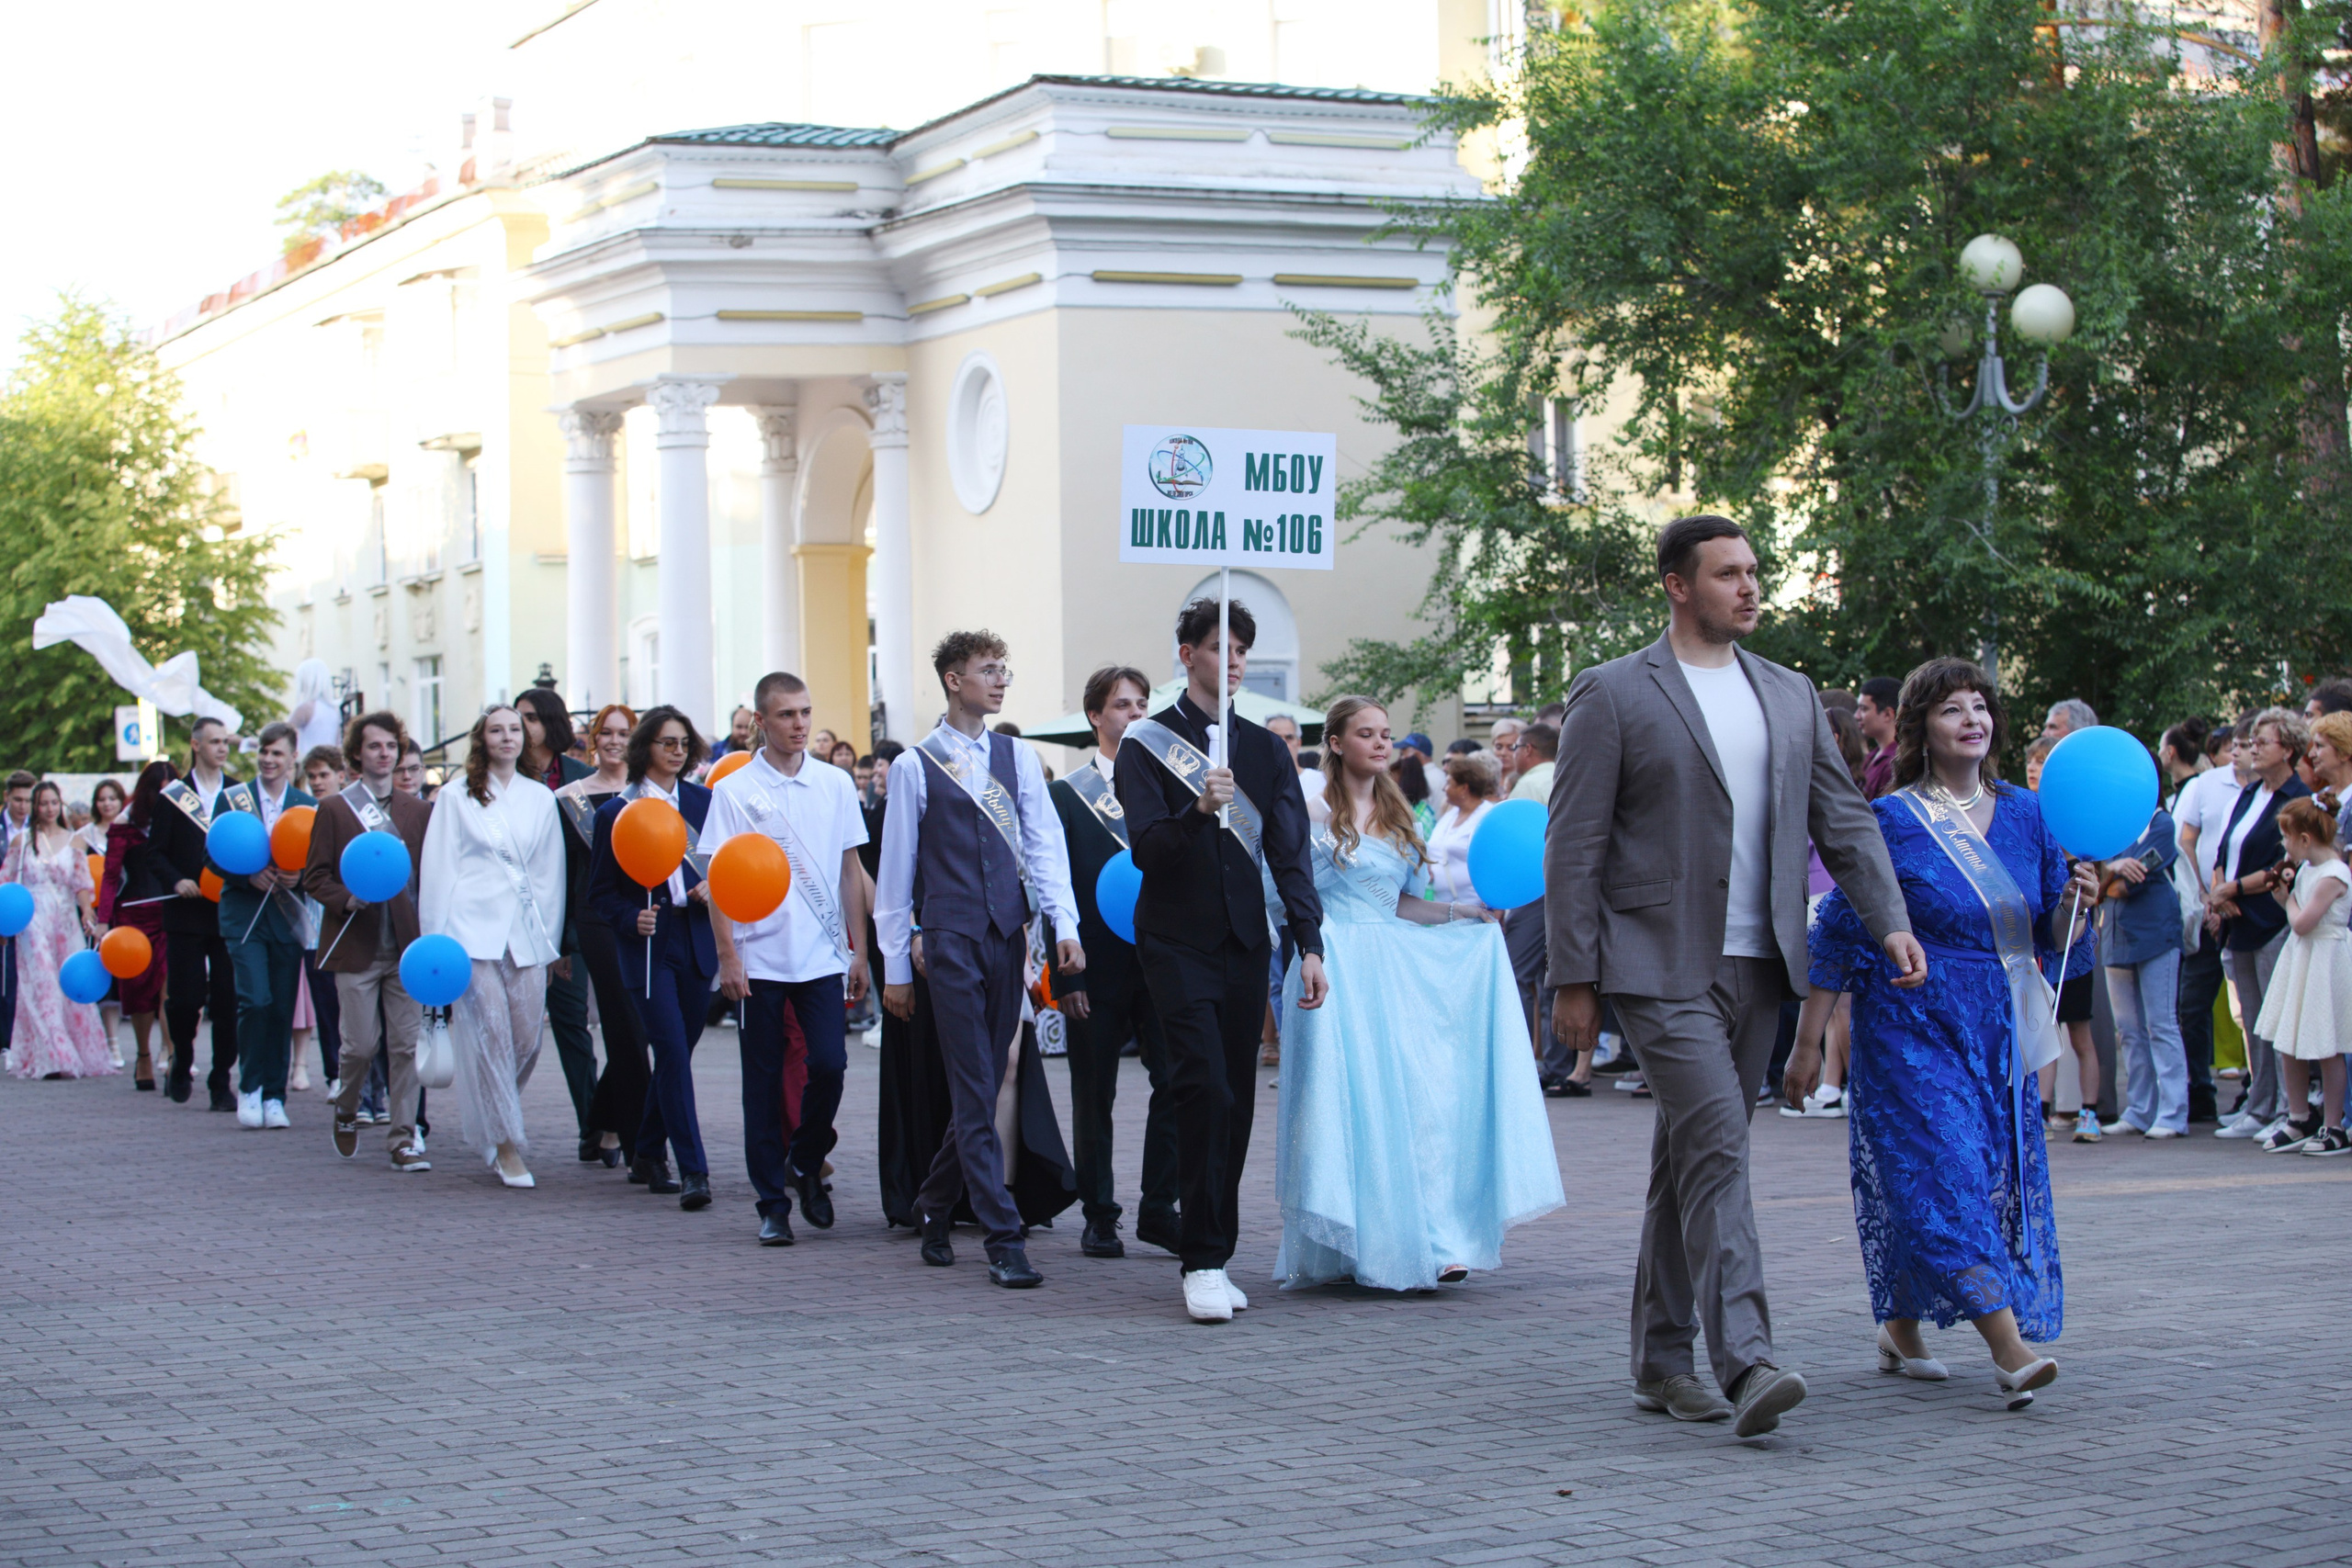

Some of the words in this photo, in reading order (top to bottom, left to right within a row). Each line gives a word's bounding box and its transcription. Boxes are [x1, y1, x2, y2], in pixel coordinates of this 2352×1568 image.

[1245, 452, 1324, 494] МБОУ
[1131, 508, 1227, 550] ШКОЛА
[1242, 513, 1323, 555] №106
